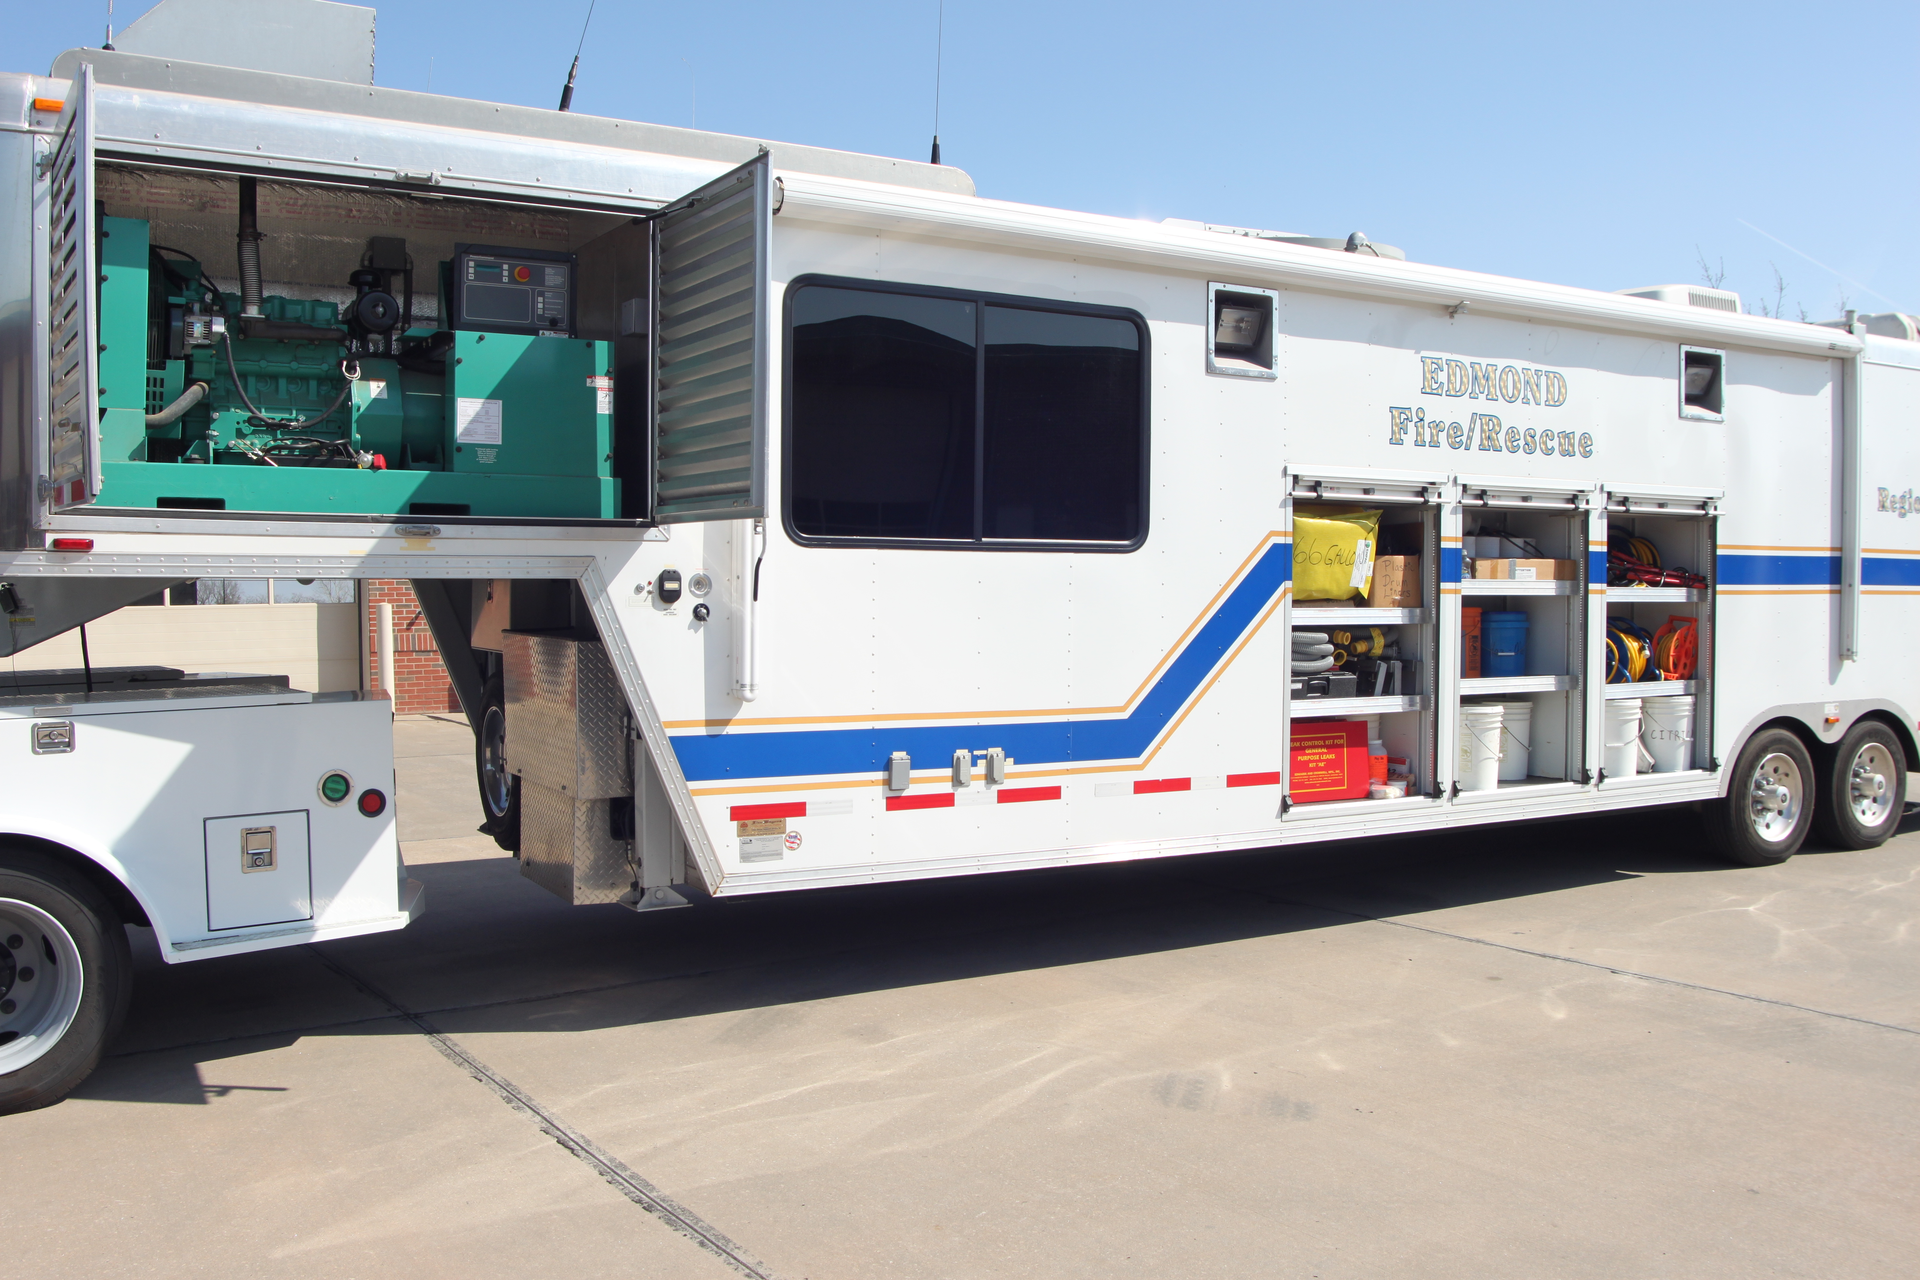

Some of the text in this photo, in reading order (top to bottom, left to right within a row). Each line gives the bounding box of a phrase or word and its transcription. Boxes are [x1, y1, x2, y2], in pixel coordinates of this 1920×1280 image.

[1421, 356, 1567, 407] EDMOND
[1389, 406, 1594, 458] Fire/Rescue
[1293, 536, 1322, 565] 66
[1382, 574, 1408, 587] Drum
[1383, 588, 1411, 599] Liners
